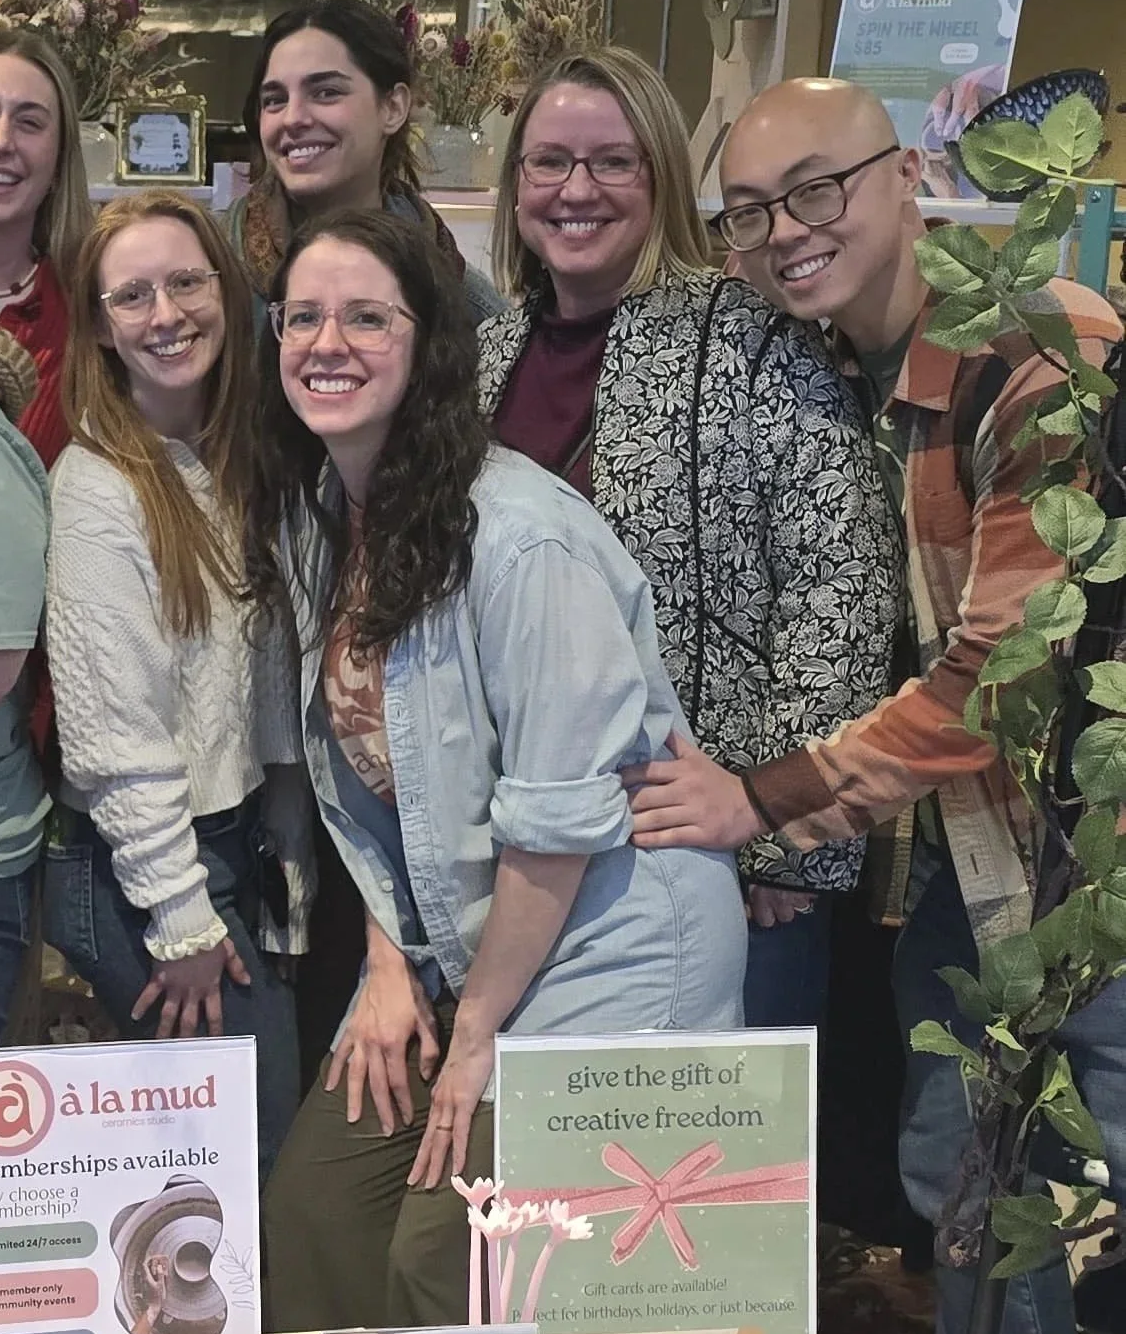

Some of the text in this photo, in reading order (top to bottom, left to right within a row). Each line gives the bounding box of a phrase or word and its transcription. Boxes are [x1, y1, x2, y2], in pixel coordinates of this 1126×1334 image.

[856, 20, 979, 37] SPIN THE WHEEL
[854, 40, 882, 55] $85
[567, 1061, 745, 1094] give the gift of
[59, 1075, 217, 1116] à la mud
[102, 1116, 176, 1129] ceramics studio
[547, 1104, 764, 1132] creative freedom
[123, 1147, 219, 1170] available
[9, 1187, 65, 1202] choose
[70, 1187, 79, 1198] a
[27, 1237, 47, 1248] 24/7
[49, 1236, 82, 1246] access
[0, 1284, 63, 1296] member only
[584, 1279, 727, 1297] Gift cards are available!
[44, 1296, 76, 1305] events
[512, 1307, 557, 1324] Pfect
[561, 1307, 579, 1320] for
[702, 1304, 716, 1314] or
[718, 1300, 742, 1315] just
